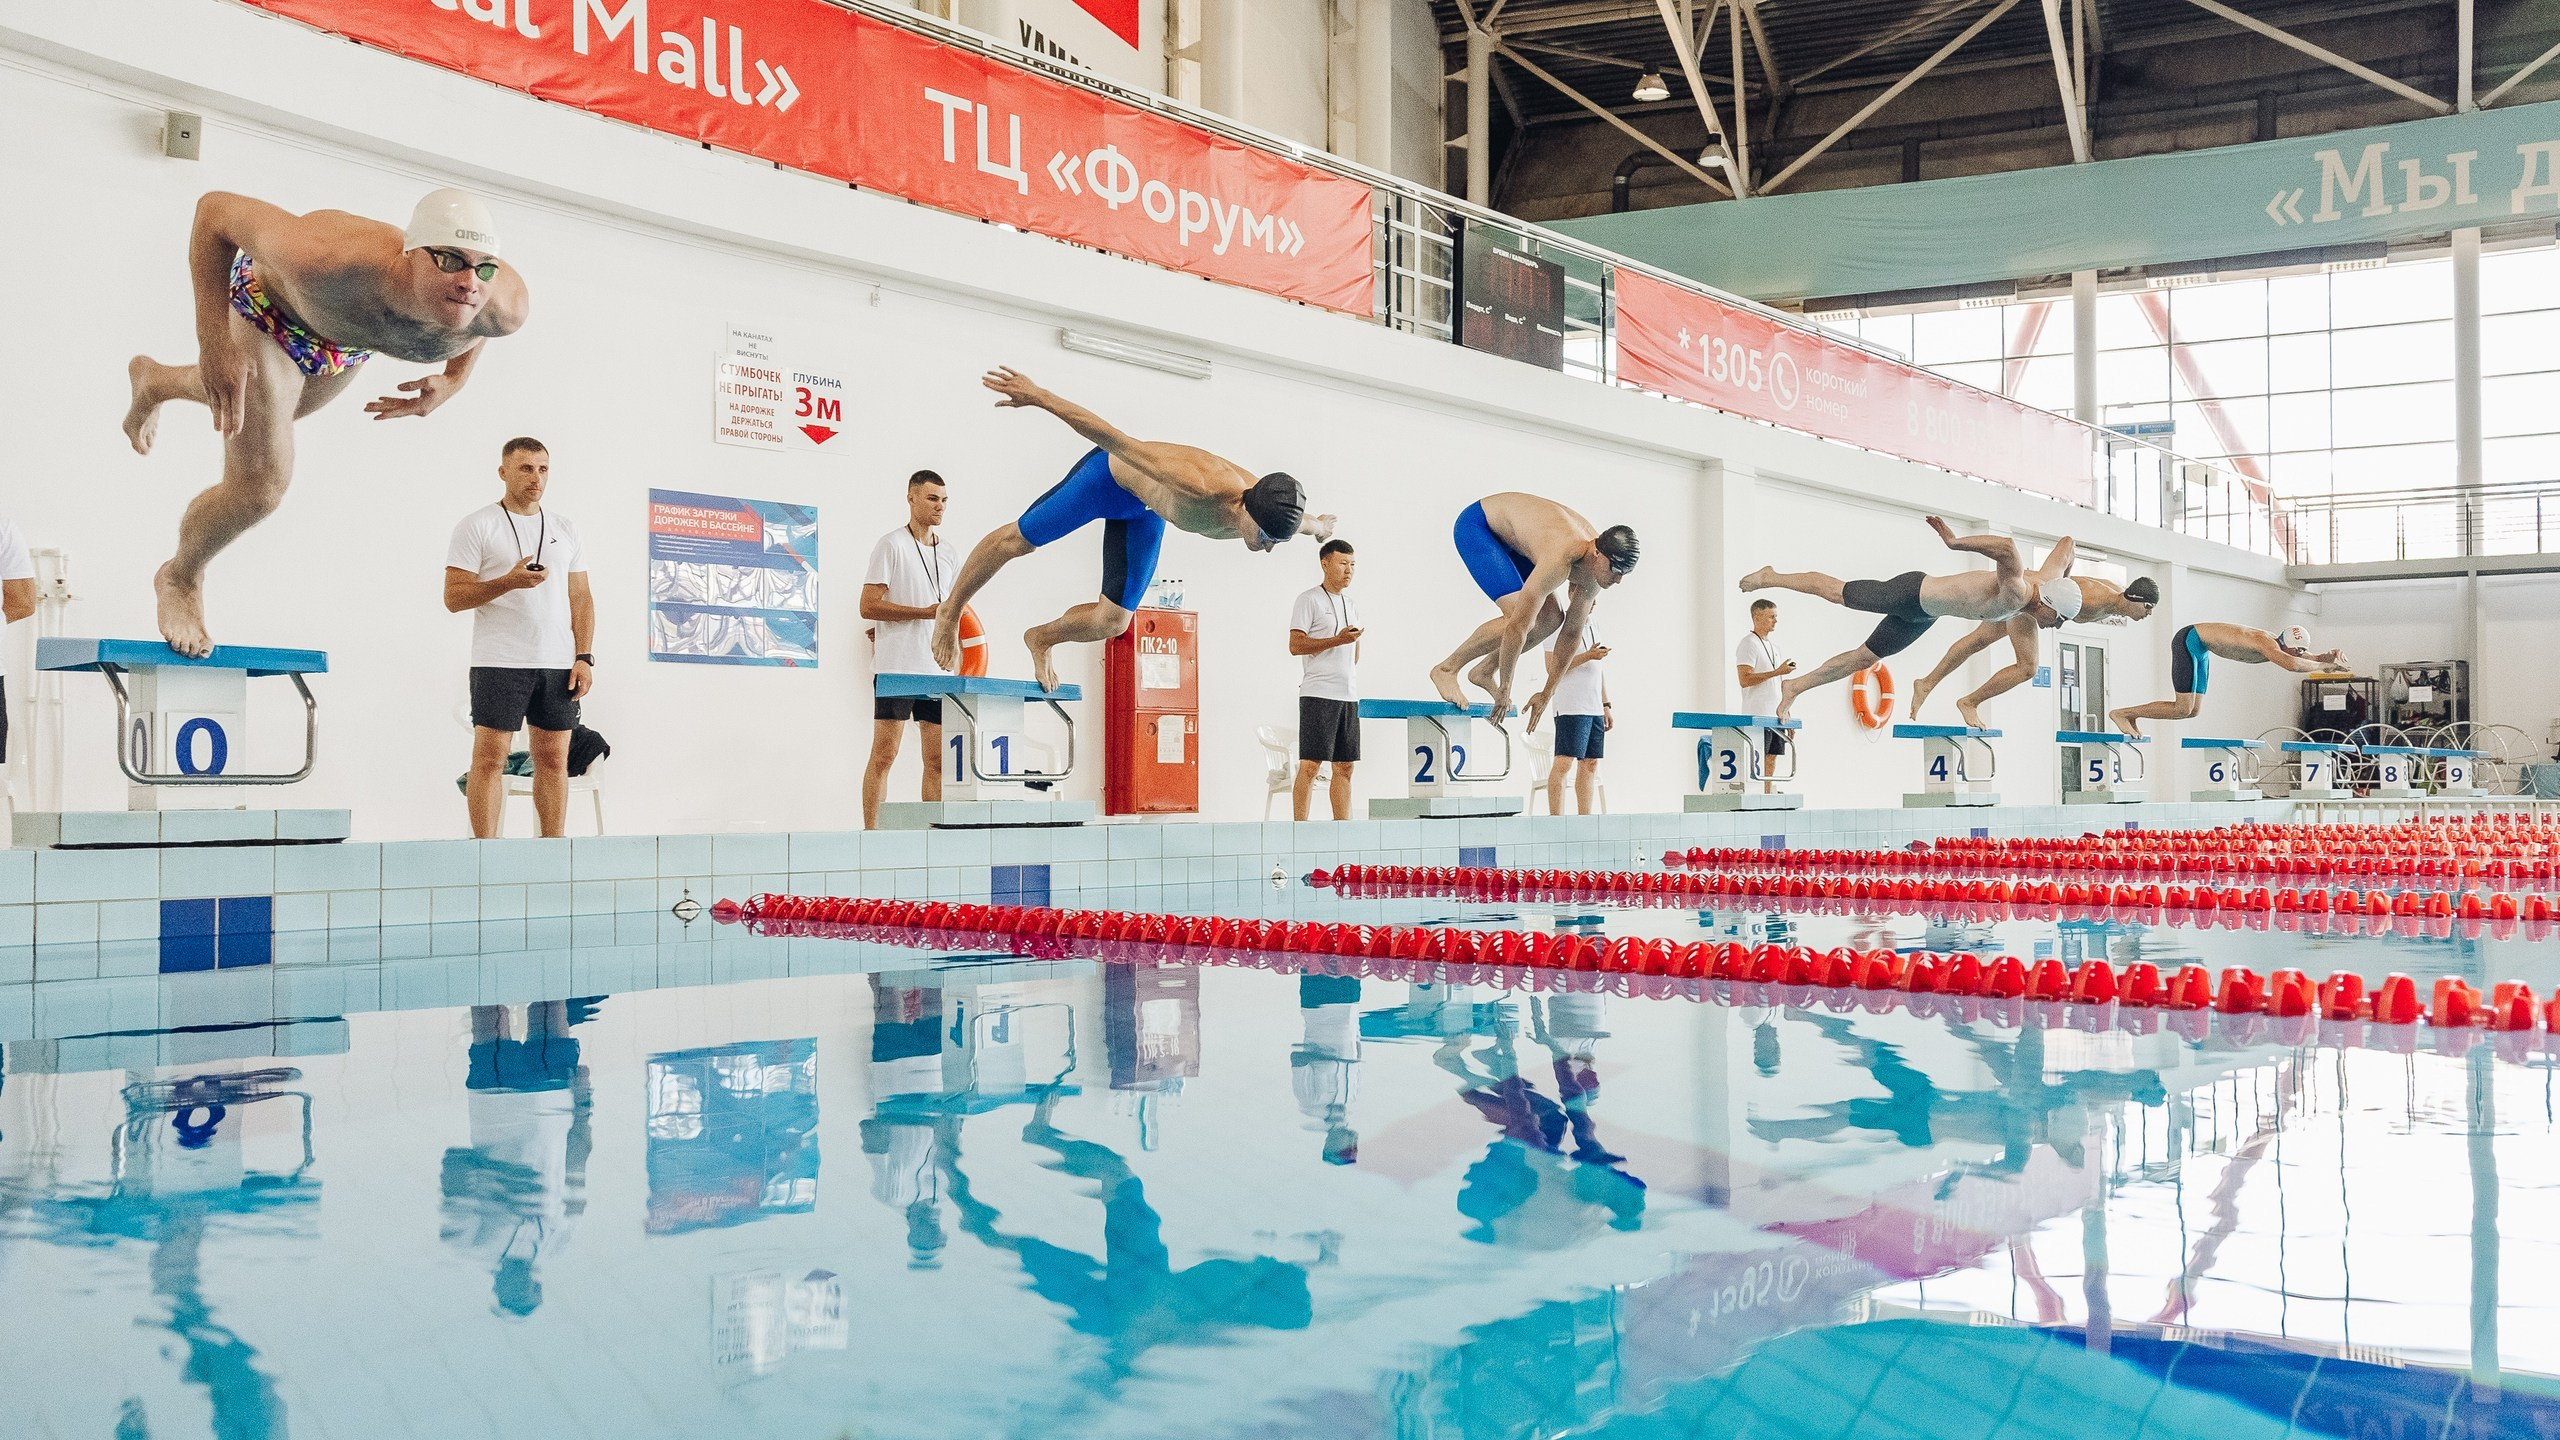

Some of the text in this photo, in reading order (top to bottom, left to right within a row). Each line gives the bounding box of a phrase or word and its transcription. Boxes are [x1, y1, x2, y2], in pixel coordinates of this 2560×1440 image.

[573, 0, 800, 113] Mall»
[924, 87, 1306, 258] ТЦ «Форум»
[2265, 142, 2479, 226] «Мы
[455, 228, 495, 246] arena
[732, 329, 773, 343] НА КАНАТАХ
[748, 342, 758, 350] НЕ
[736, 349, 769, 361] ВИСНУТЬ!
[720, 362, 782, 384] С ТУМБОЧЕК
[793, 372, 842, 389] ГЛУБИНА
[1806, 366, 1868, 399] короткий
[719, 381, 783, 402] НЕ ПРЫГАТЬ!
[729, 402, 775, 417] НА ДОРОЖКЕ
[1806, 394, 1848, 424] номер
[731, 415, 773, 429] ДЕРЖАТЬСЯ
[1907, 400, 1919, 436] 8
[1925, 405, 1961, 447] 800
[720, 427, 783, 444] ПРАВОЙ СТОРОНЫ
[654, 504, 737, 521] ГРАФИК ЗАГРУЗКИ
[653, 515, 755, 534] ДОРОЖЕК В БАССЕЙНЕ
[2292, 627, 2303, 641] RUS
[175, 717, 228, 777] 0
[991, 735, 1009, 775] 1
[950, 735, 963, 782] 1
[1414, 745, 1434, 783] 2
[1720, 749, 1737, 780] 3
[1929, 755, 1948, 781] 4
[2088, 759, 2104, 783] 5
[2209, 762, 2224, 782] 6
[2231, 763, 2238, 782] 6
[2306, 764, 2319, 782] 7
[2385, 766, 2397, 782] 8
[2451, 767, 2463, 782] 9
